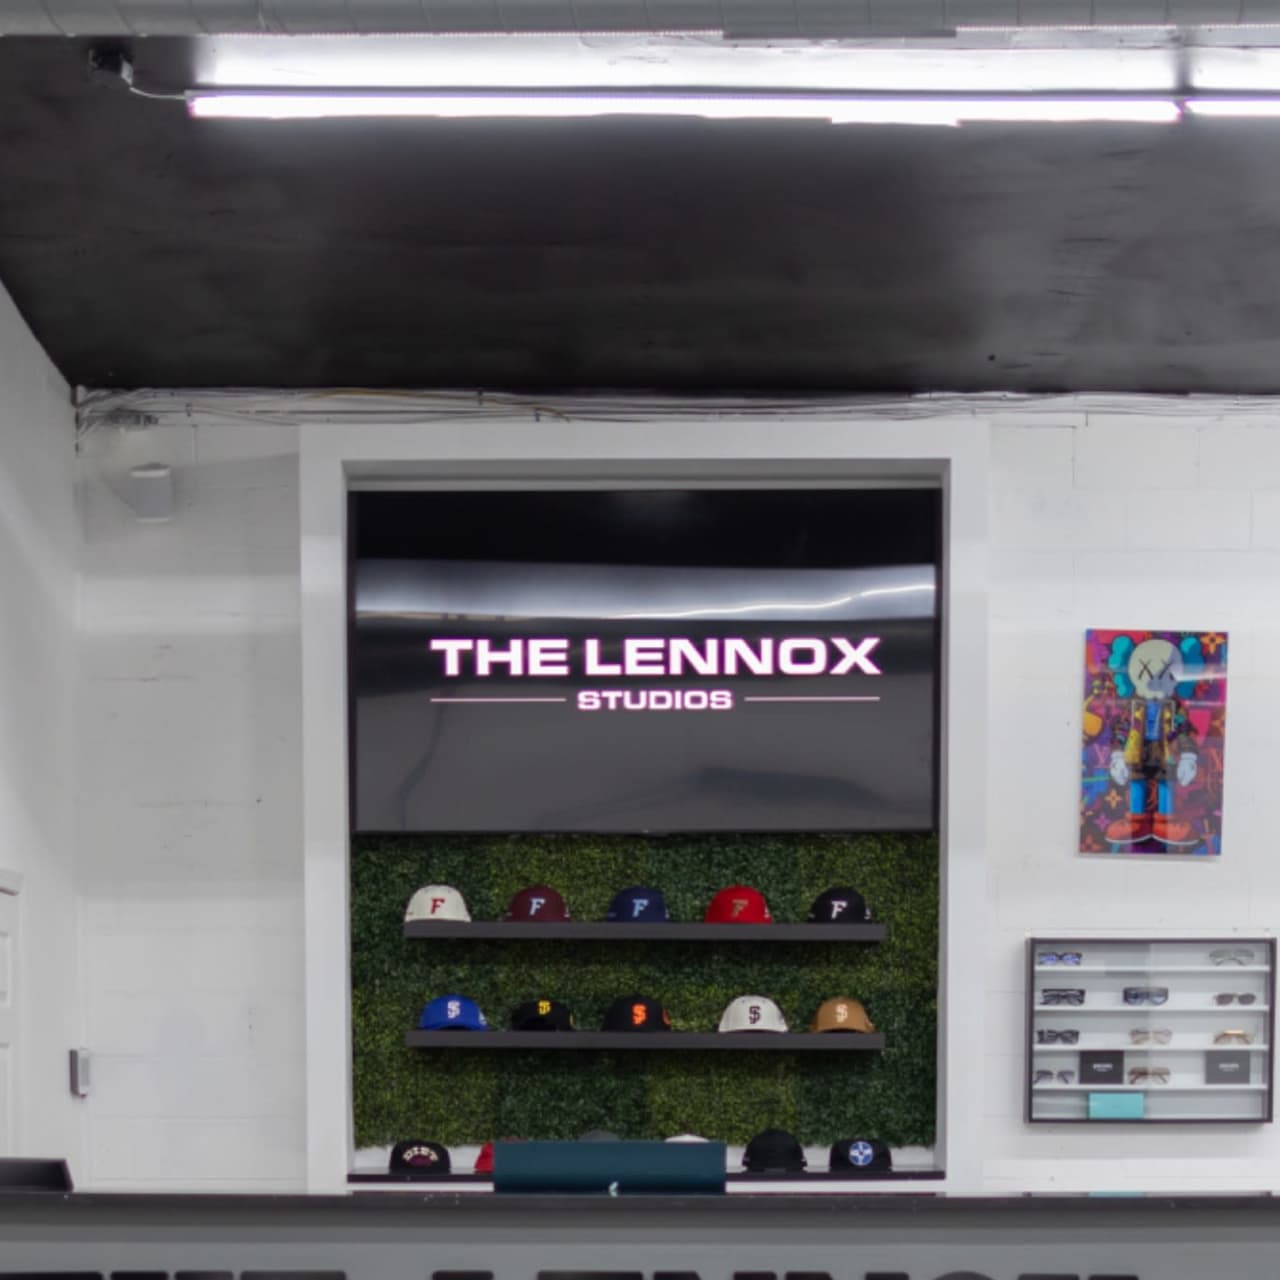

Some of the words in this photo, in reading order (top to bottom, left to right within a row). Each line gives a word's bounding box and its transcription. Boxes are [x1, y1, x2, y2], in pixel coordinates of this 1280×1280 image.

[429, 639, 569, 676] THE
[584, 638, 881, 676] LENNOX
[577, 690, 733, 710] STUDIOS
[430, 898, 445, 915] F
[529, 898, 545, 915] F
[633, 899, 648, 917] F
[831, 901, 847, 919] F
